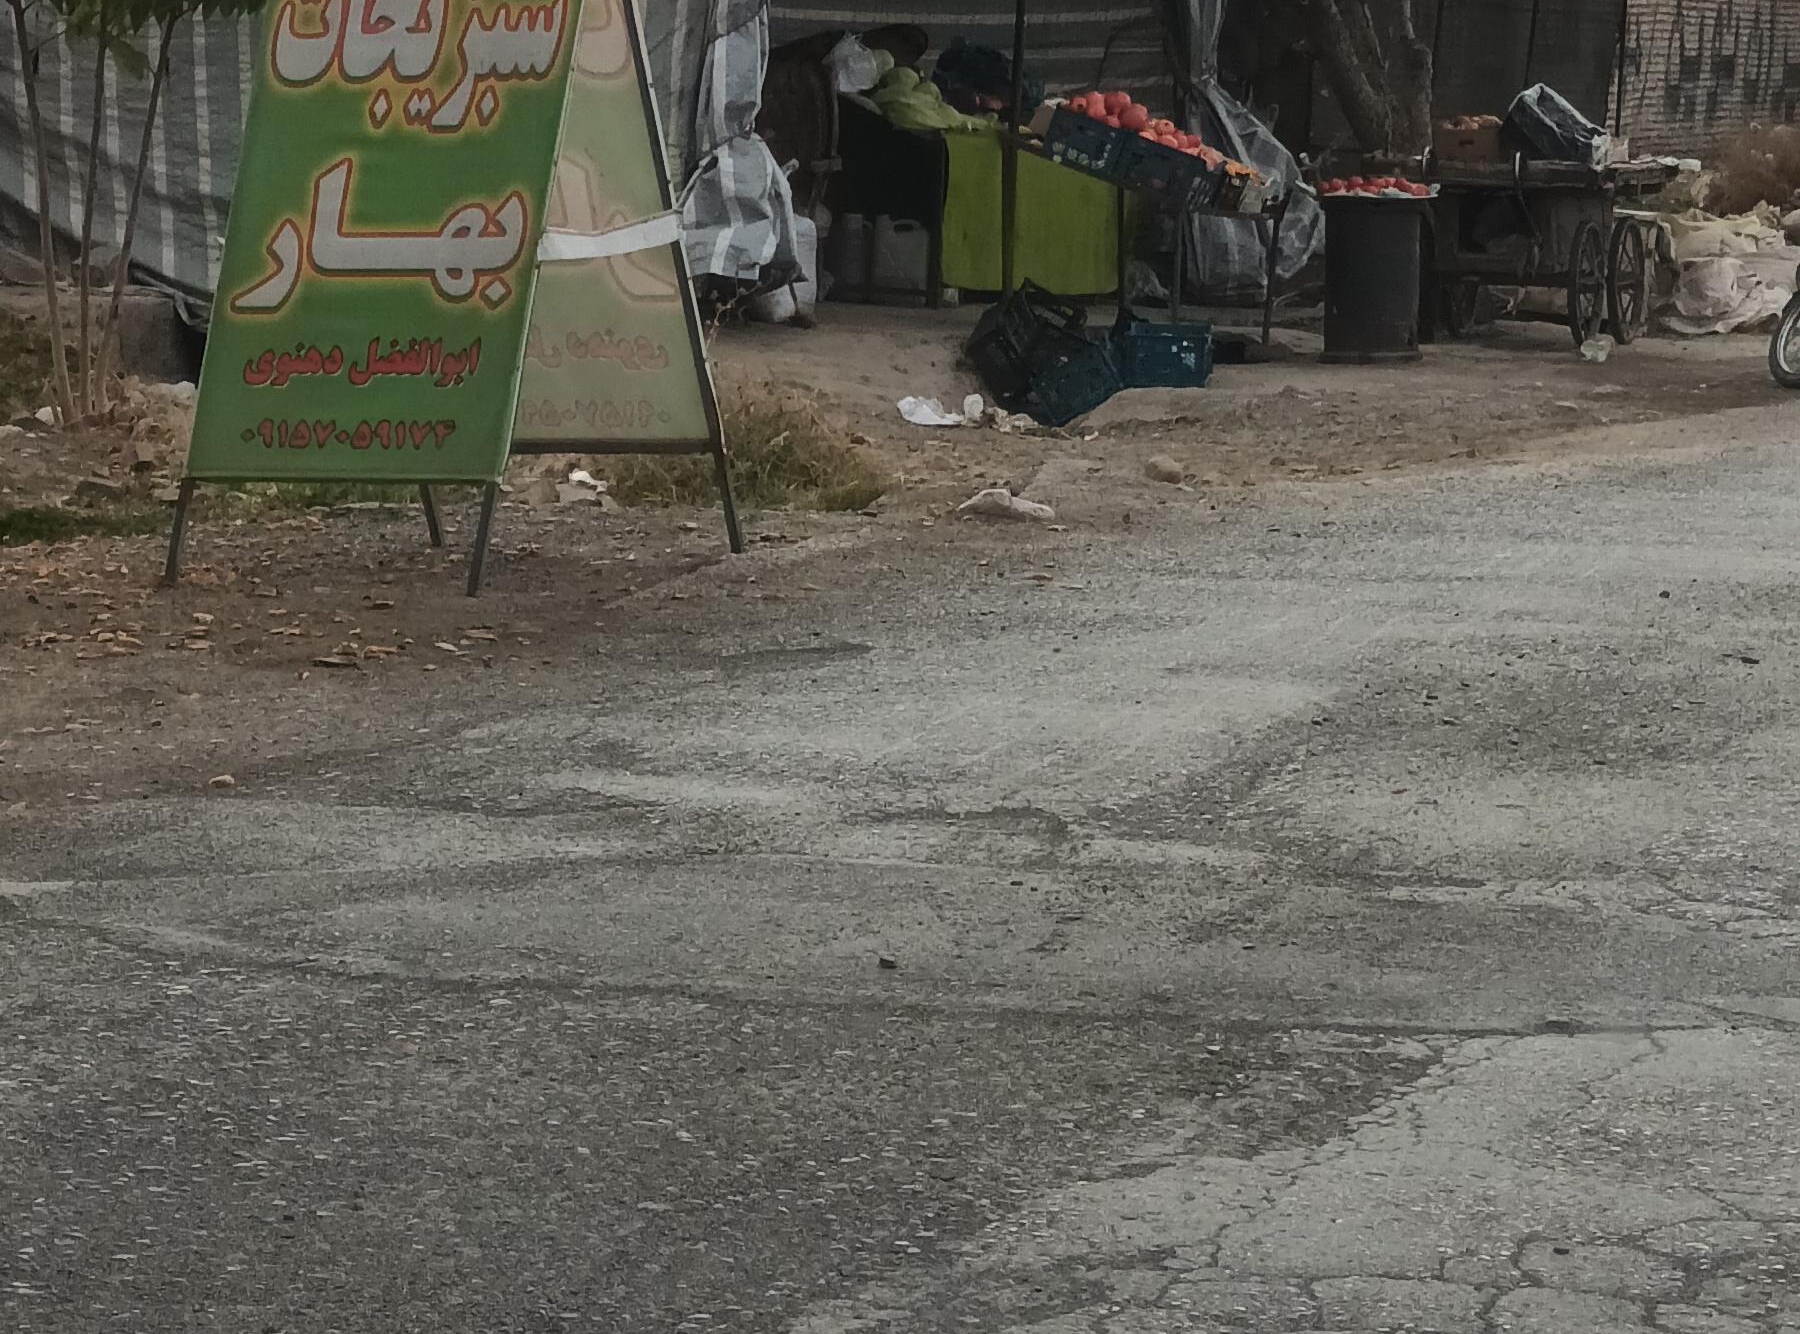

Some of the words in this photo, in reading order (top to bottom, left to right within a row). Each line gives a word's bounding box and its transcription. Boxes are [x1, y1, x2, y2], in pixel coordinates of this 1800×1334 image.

[229, 157, 528, 314] بهار
[242, 341, 344, 388] دهنوی
[348, 336, 482, 388] ابوالفضل
